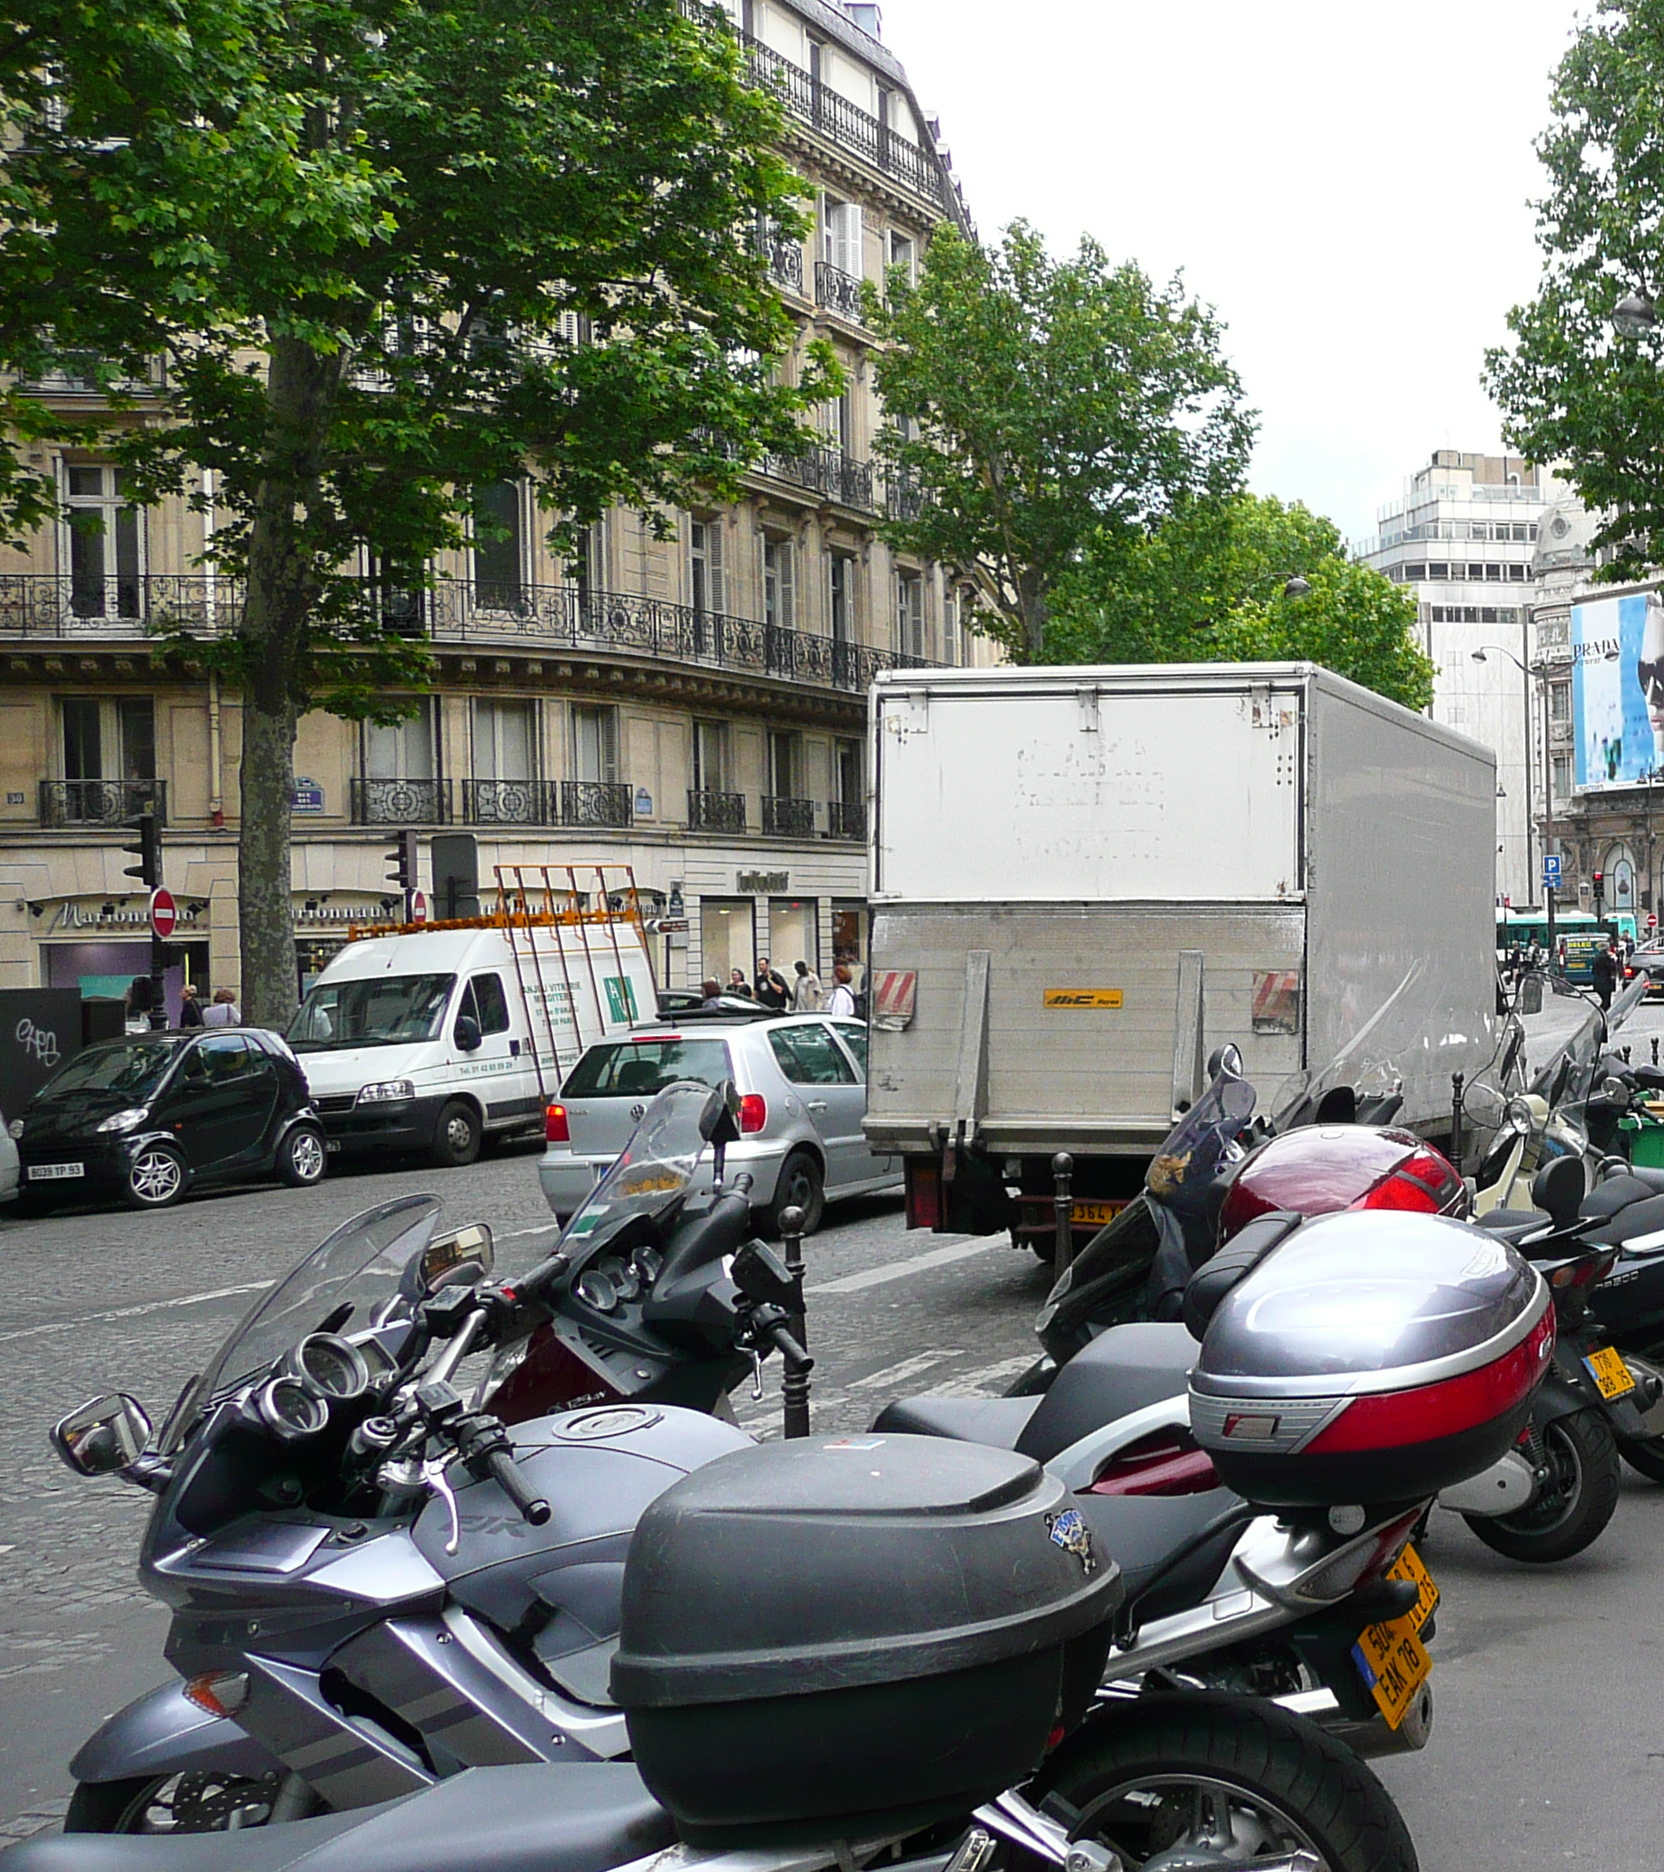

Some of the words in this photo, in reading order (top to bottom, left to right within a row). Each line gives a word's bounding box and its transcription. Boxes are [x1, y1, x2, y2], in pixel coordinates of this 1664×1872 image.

[1573, 637, 1620, 658] PRADA
[1548, 859, 1556, 870] P
[1378, 1653, 1408, 1708] EAK
[1397, 1637, 1420, 1674] 78
